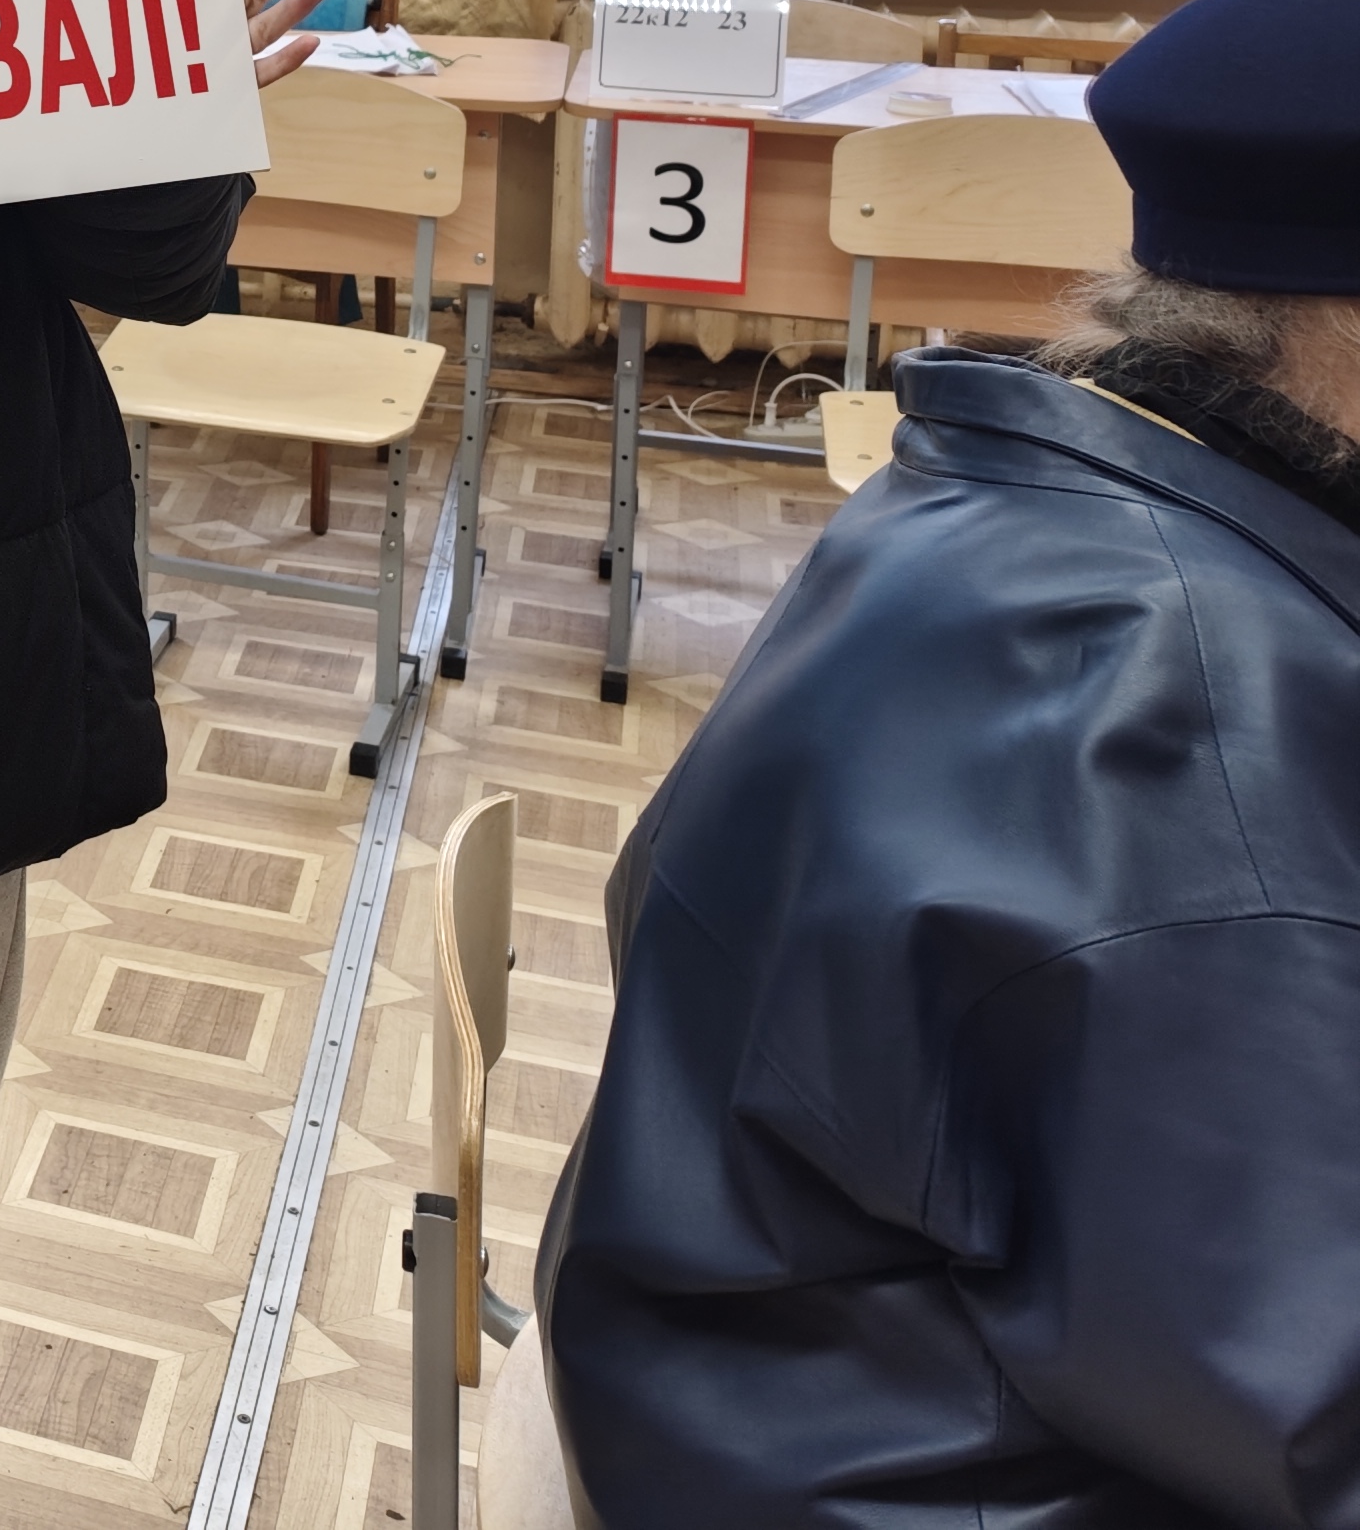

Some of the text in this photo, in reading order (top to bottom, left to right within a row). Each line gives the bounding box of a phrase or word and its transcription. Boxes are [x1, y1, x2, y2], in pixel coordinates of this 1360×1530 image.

[615, 4, 748, 31] 22к12 23
[649, 162, 706, 244] 3
